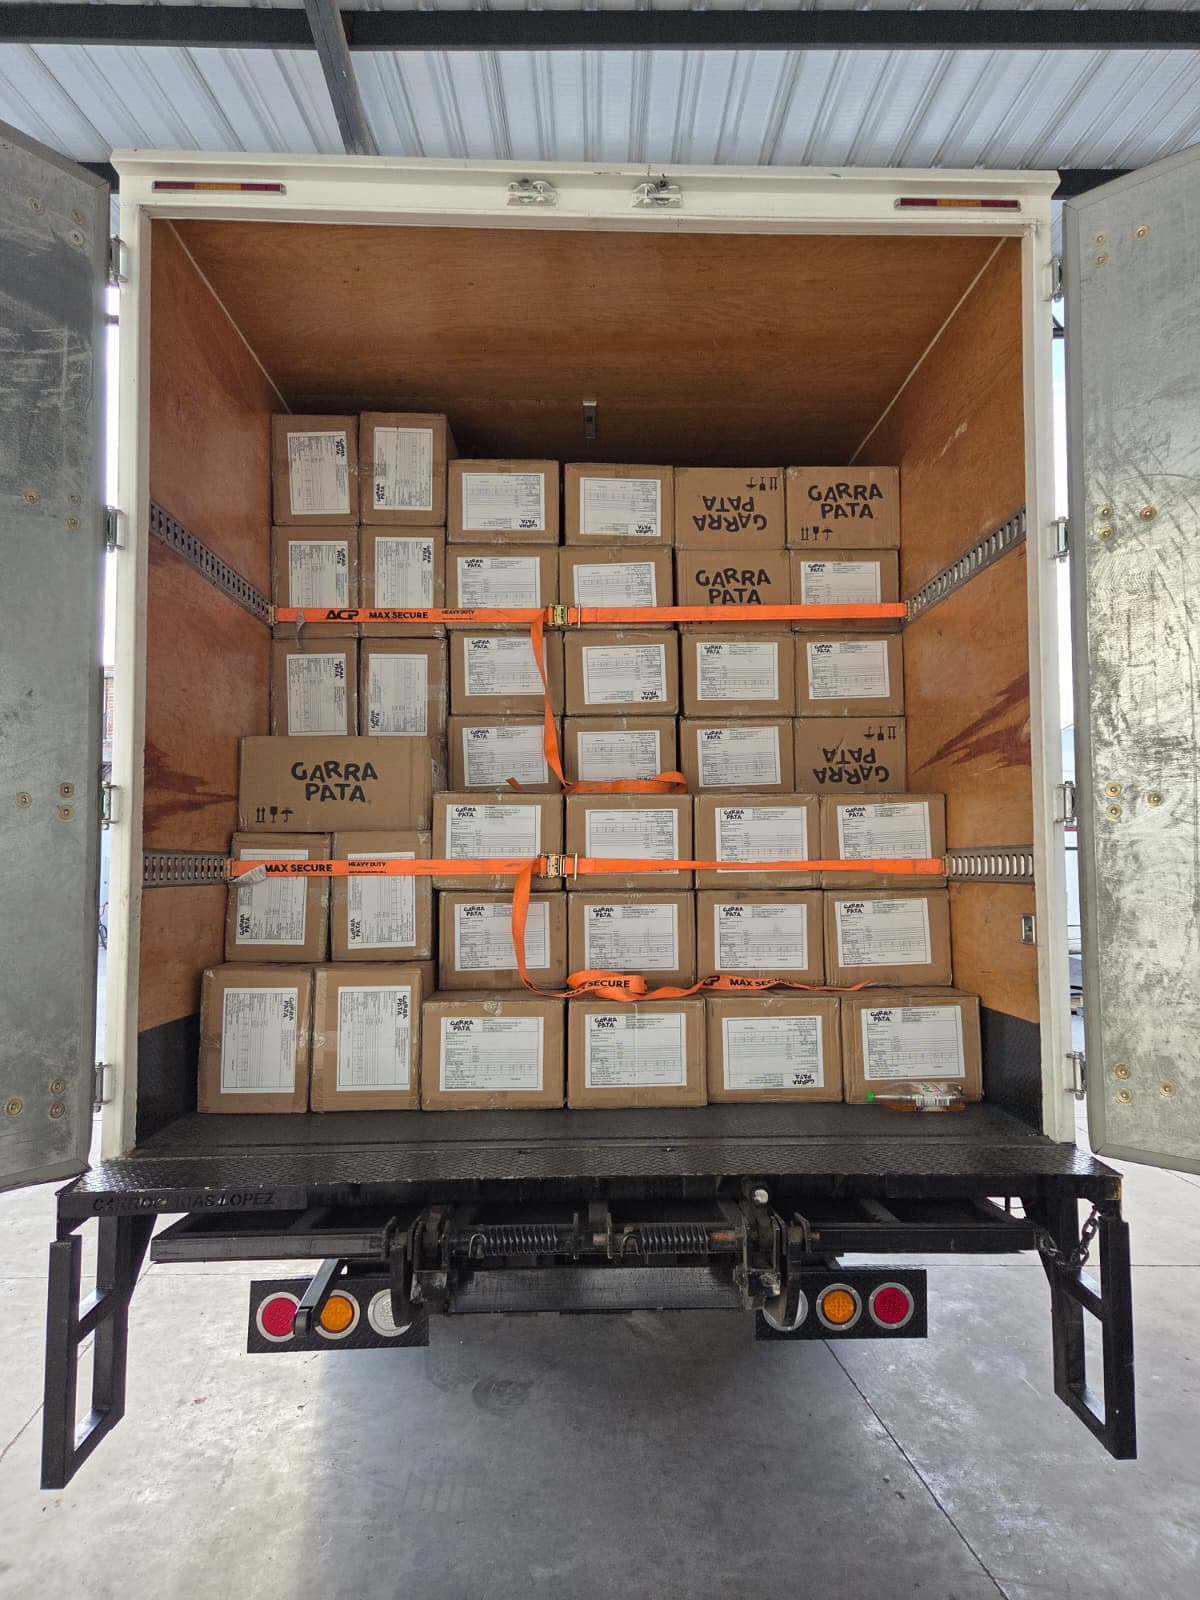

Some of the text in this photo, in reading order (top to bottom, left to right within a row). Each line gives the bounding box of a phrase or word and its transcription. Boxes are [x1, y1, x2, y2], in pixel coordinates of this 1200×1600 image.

[807, 482, 884, 502] GARRA
[702, 495, 755, 513] PATA
[820, 502, 874, 520] PATA
[692, 513, 768, 533] GARRA
[695, 567, 771, 588] GARRA
[708, 588, 762, 605] PATA
[392, 611, 429, 619] SECURE
[822, 747, 877, 765] PATA
[291, 760, 379, 782] GARRA
[812, 765, 890, 785] GARRA
[305, 783, 366, 803] PATA
[264, 864, 333, 873] MAX SECURE
[587, 979, 630, 988] SECURE
[729, 978, 752, 986] MAX
[873, 1015, 892, 1023] PATA
